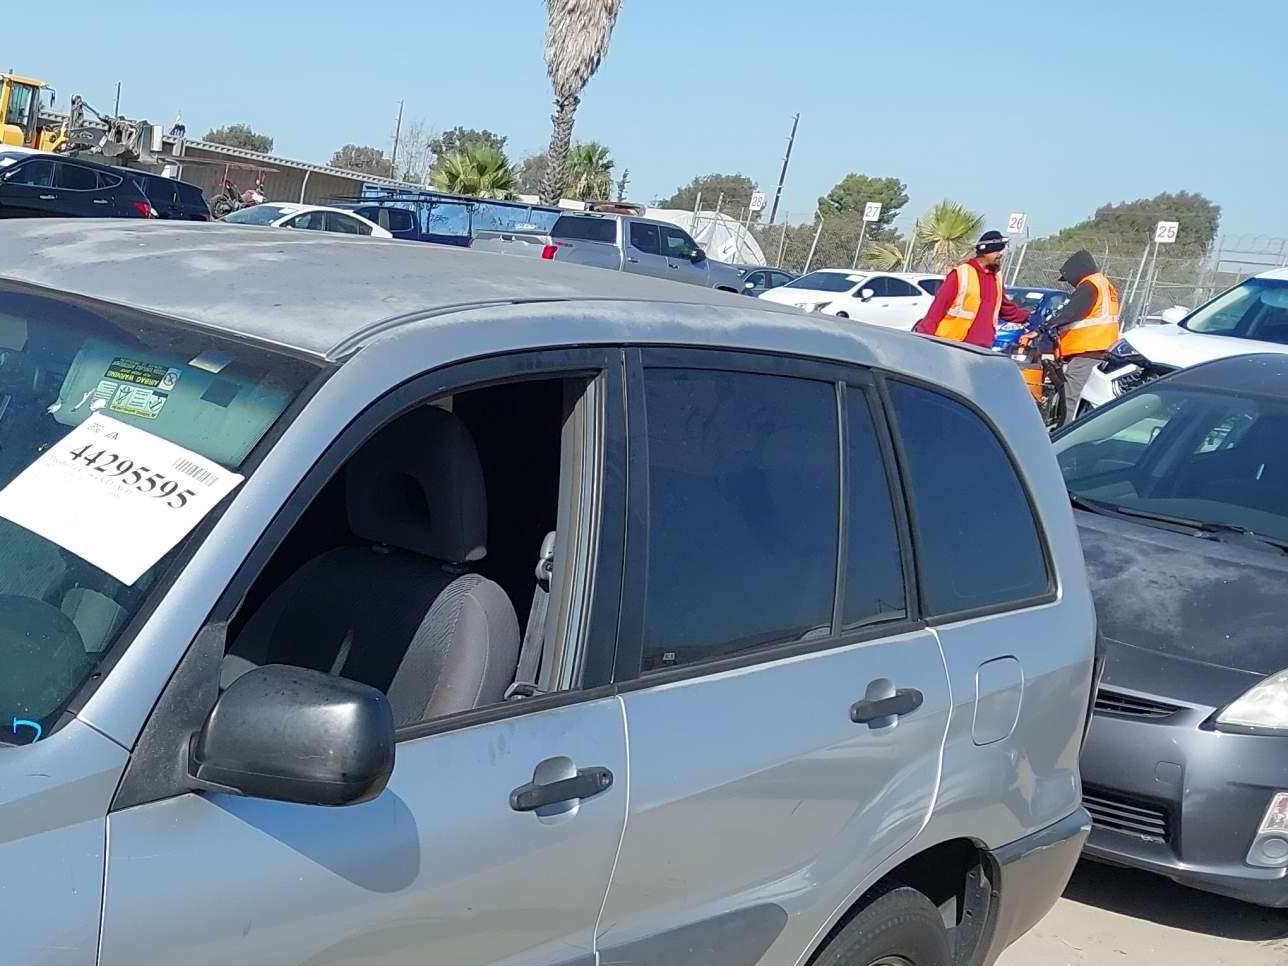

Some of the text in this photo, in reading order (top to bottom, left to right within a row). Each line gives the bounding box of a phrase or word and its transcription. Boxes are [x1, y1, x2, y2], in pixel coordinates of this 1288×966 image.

[865, 206, 881, 217] 27
[1009, 216, 1023, 230] 26
[1157, 225, 1177, 238] 25
[69, 443, 197, 509] 44295595
